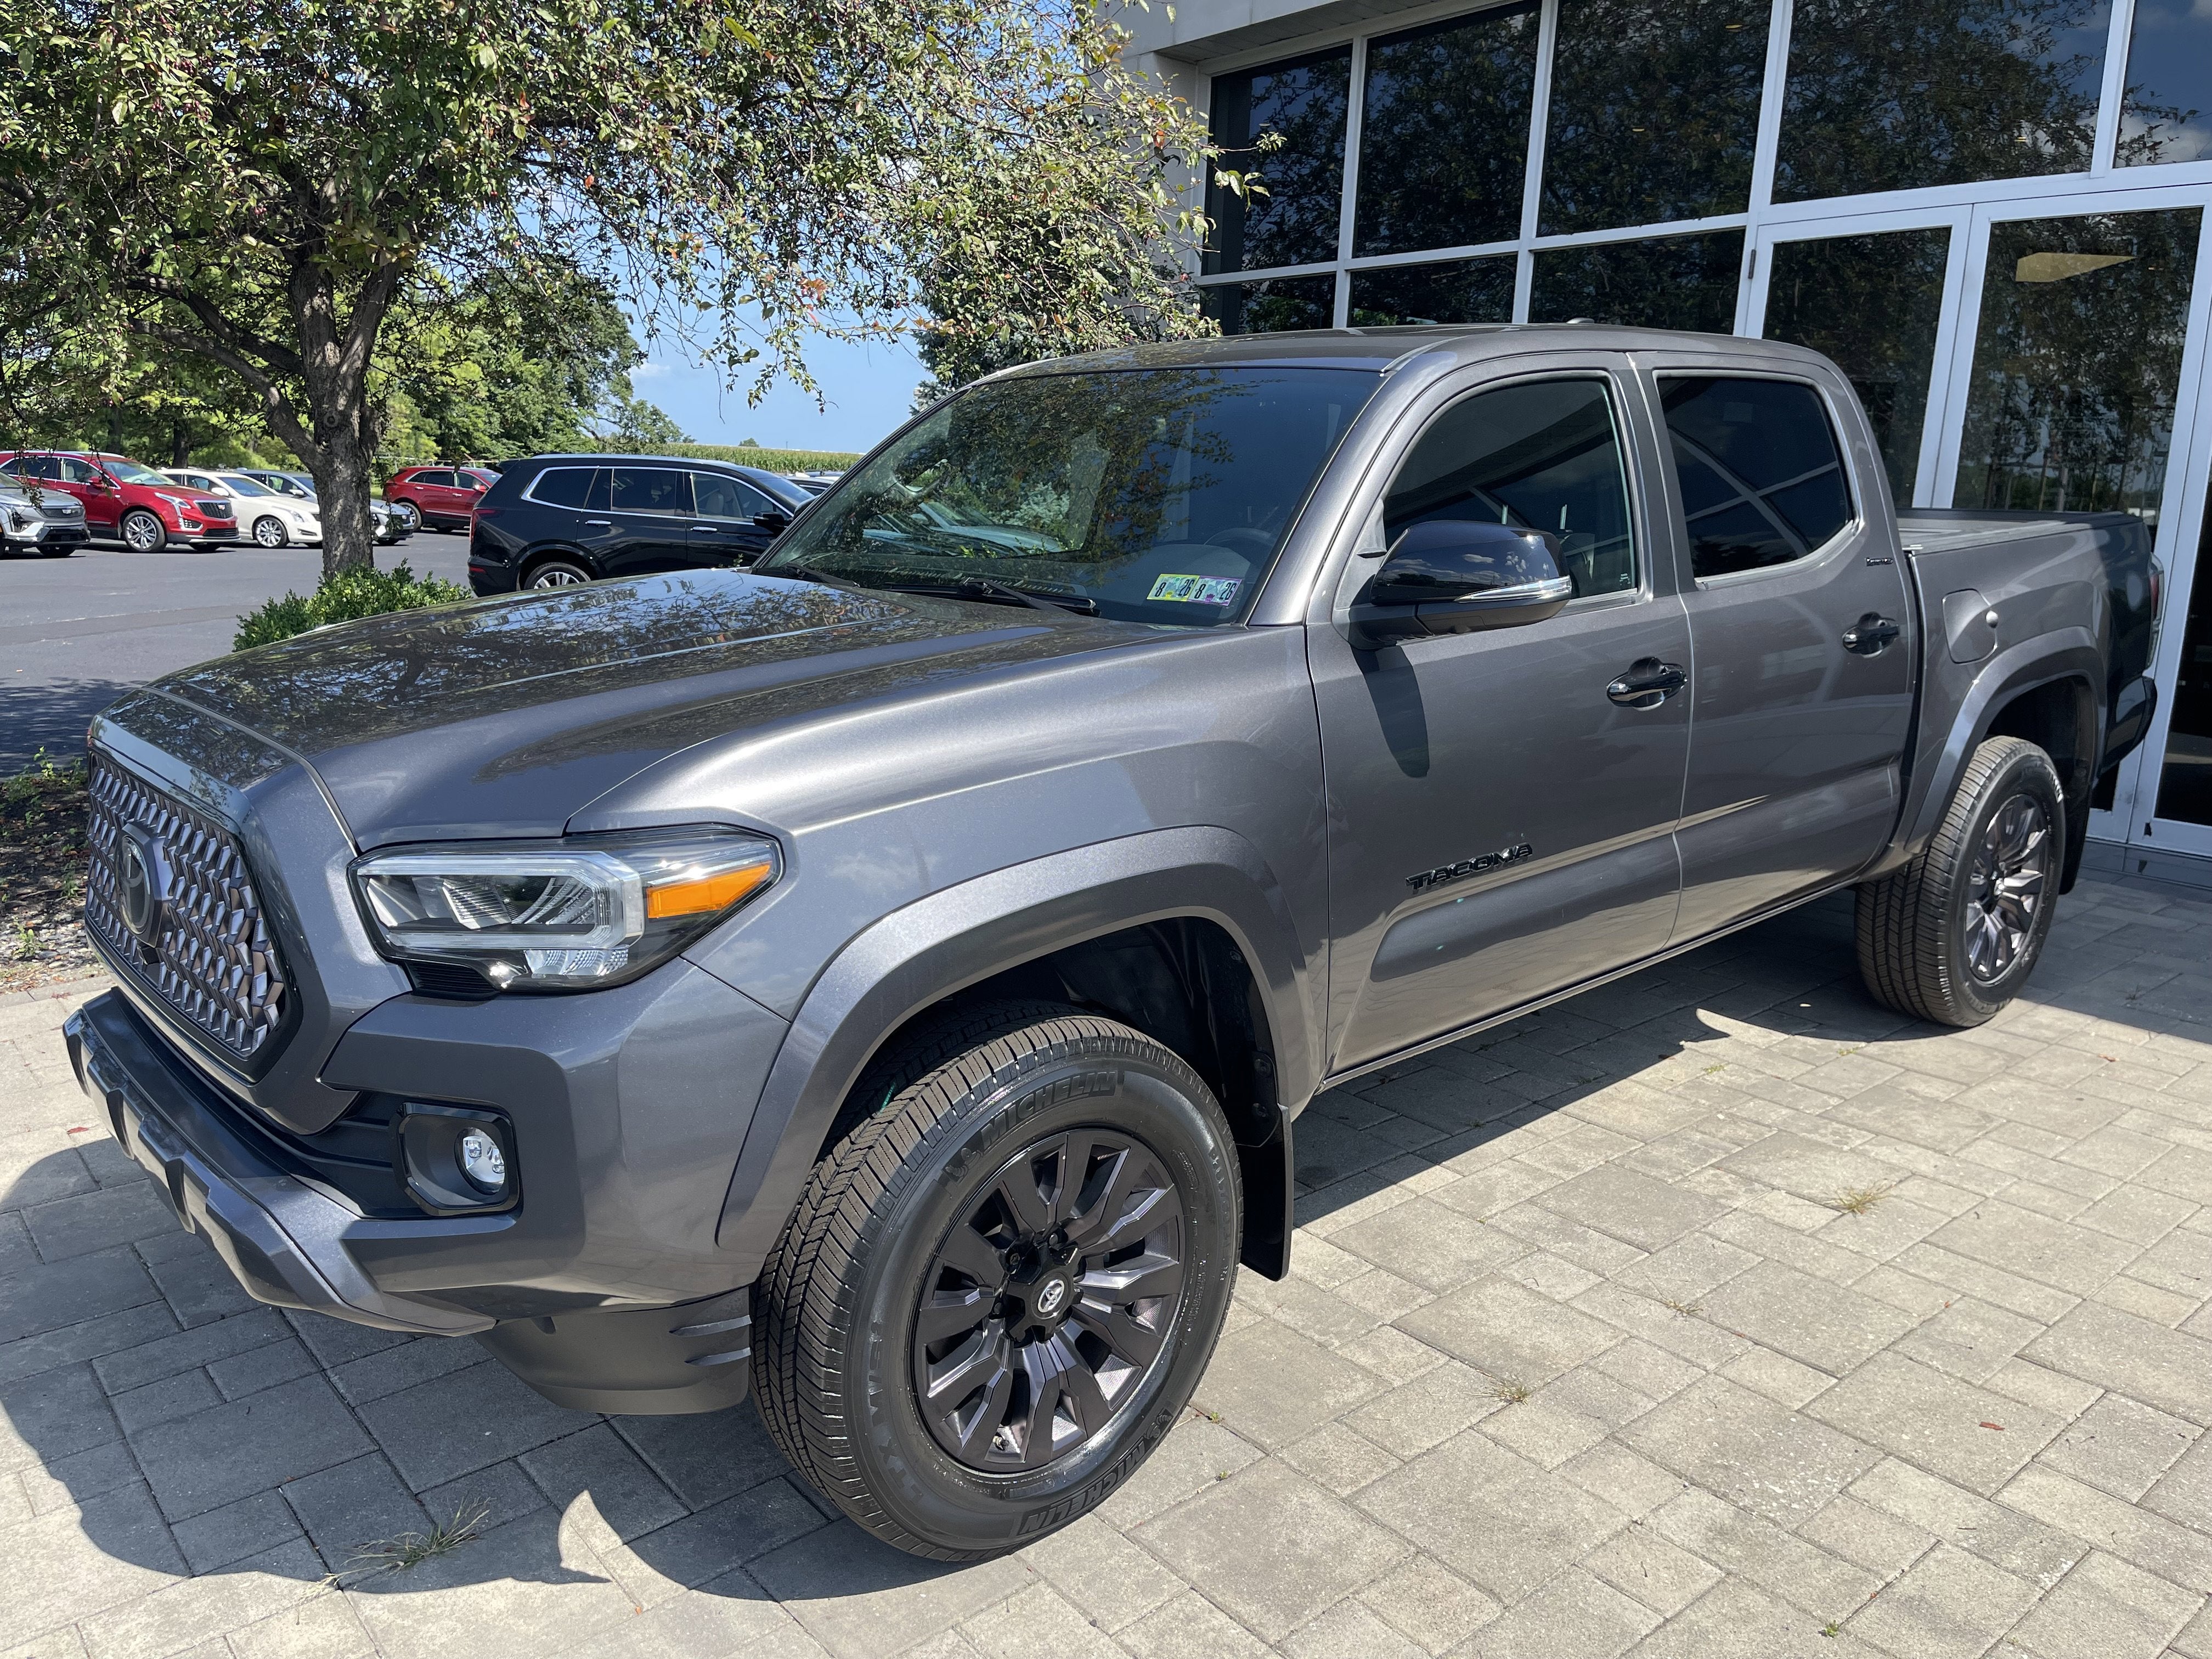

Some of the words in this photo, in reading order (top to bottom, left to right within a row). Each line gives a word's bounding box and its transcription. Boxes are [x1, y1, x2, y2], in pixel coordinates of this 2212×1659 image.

[1155, 582, 1167, 597] 8
[1178, 579, 1195, 596] 26
[1194, 583, 1206, 599] 8
[1220, 582, 1237, 600] 26
[1404, 842, 1533, 890] TACOMA
[980, 1070, 1118, 1149] MICHELIN
[1019, 1441, 1146, 1536] MICHELIN
